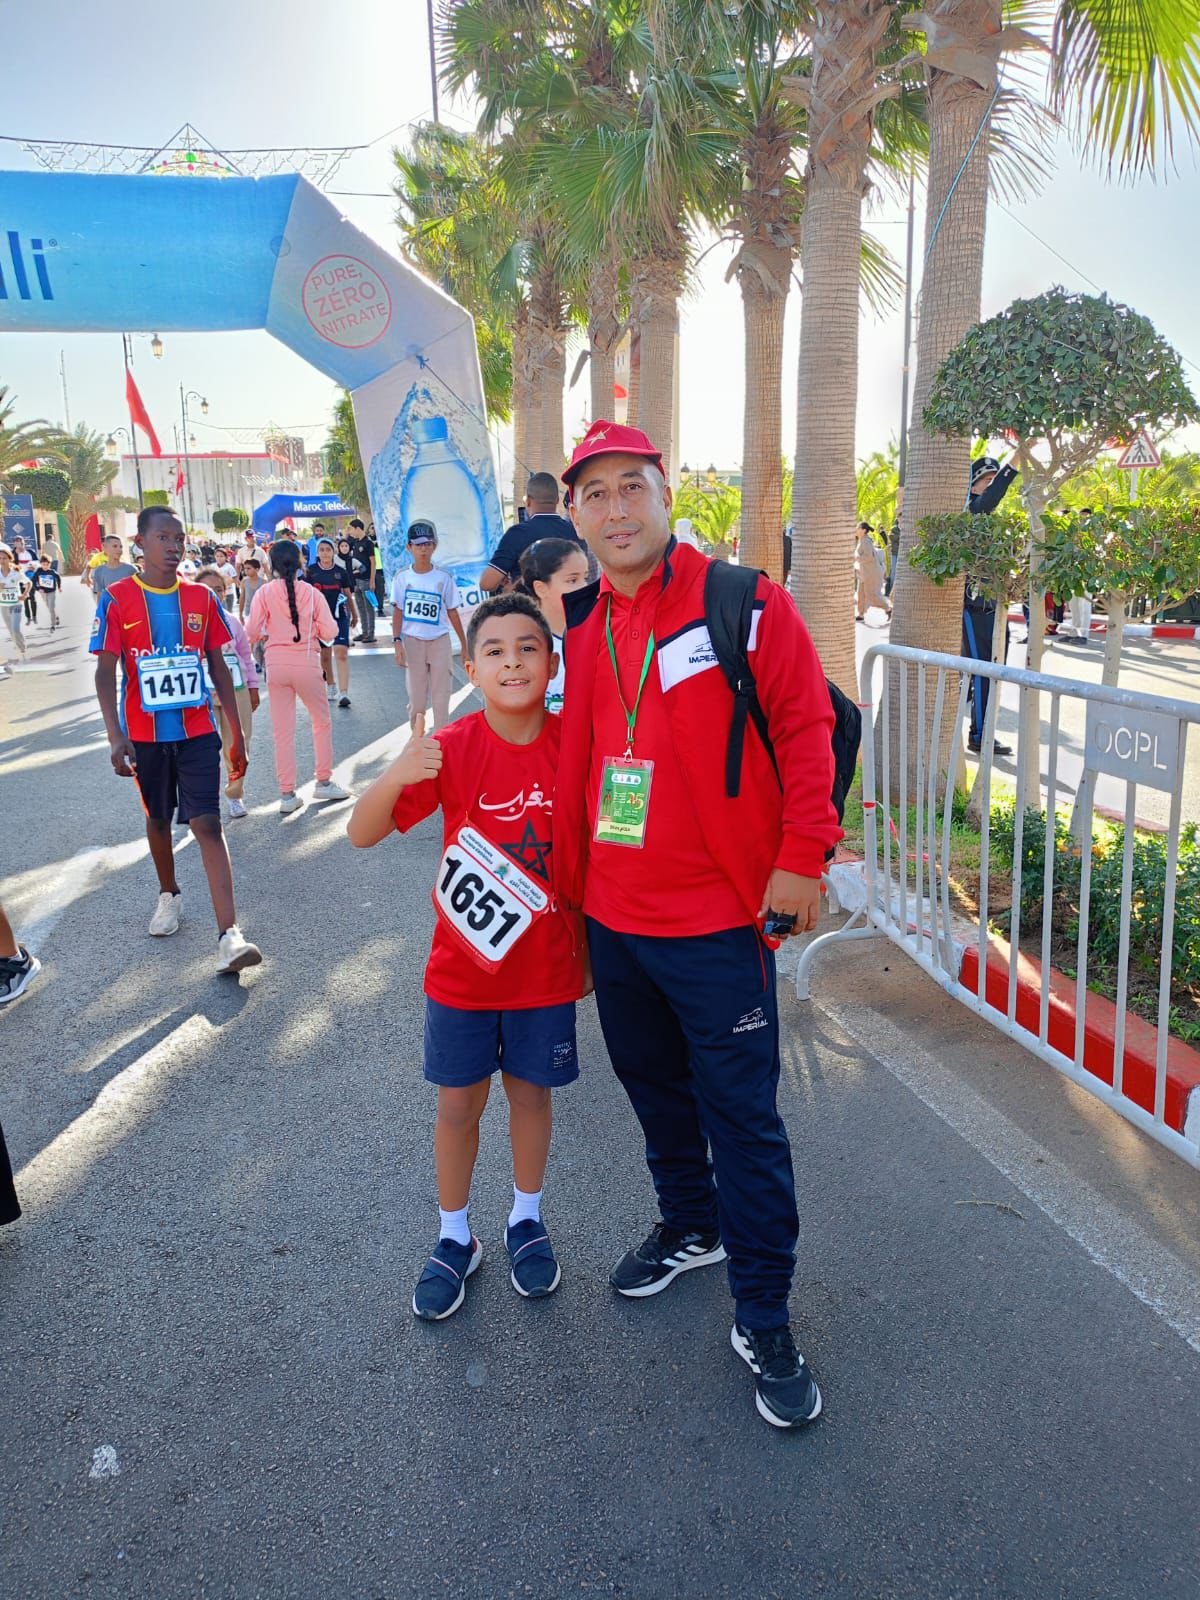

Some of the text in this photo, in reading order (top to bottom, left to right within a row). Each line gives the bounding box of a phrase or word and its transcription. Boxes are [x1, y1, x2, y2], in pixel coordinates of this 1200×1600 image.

[312, 263, 363, 291] PURE,
[312, 281, 376, 317] ZÉRO
[320, 302, 388, 336] NITRATE
[293, 501, 322, 512] Maroc
[406, 601, 438, 618] 1458
[144, 672, 198, 699] 1417
[1095, 721, 1168, 770] OCPL
[440, 856, 522, 948] 1651
